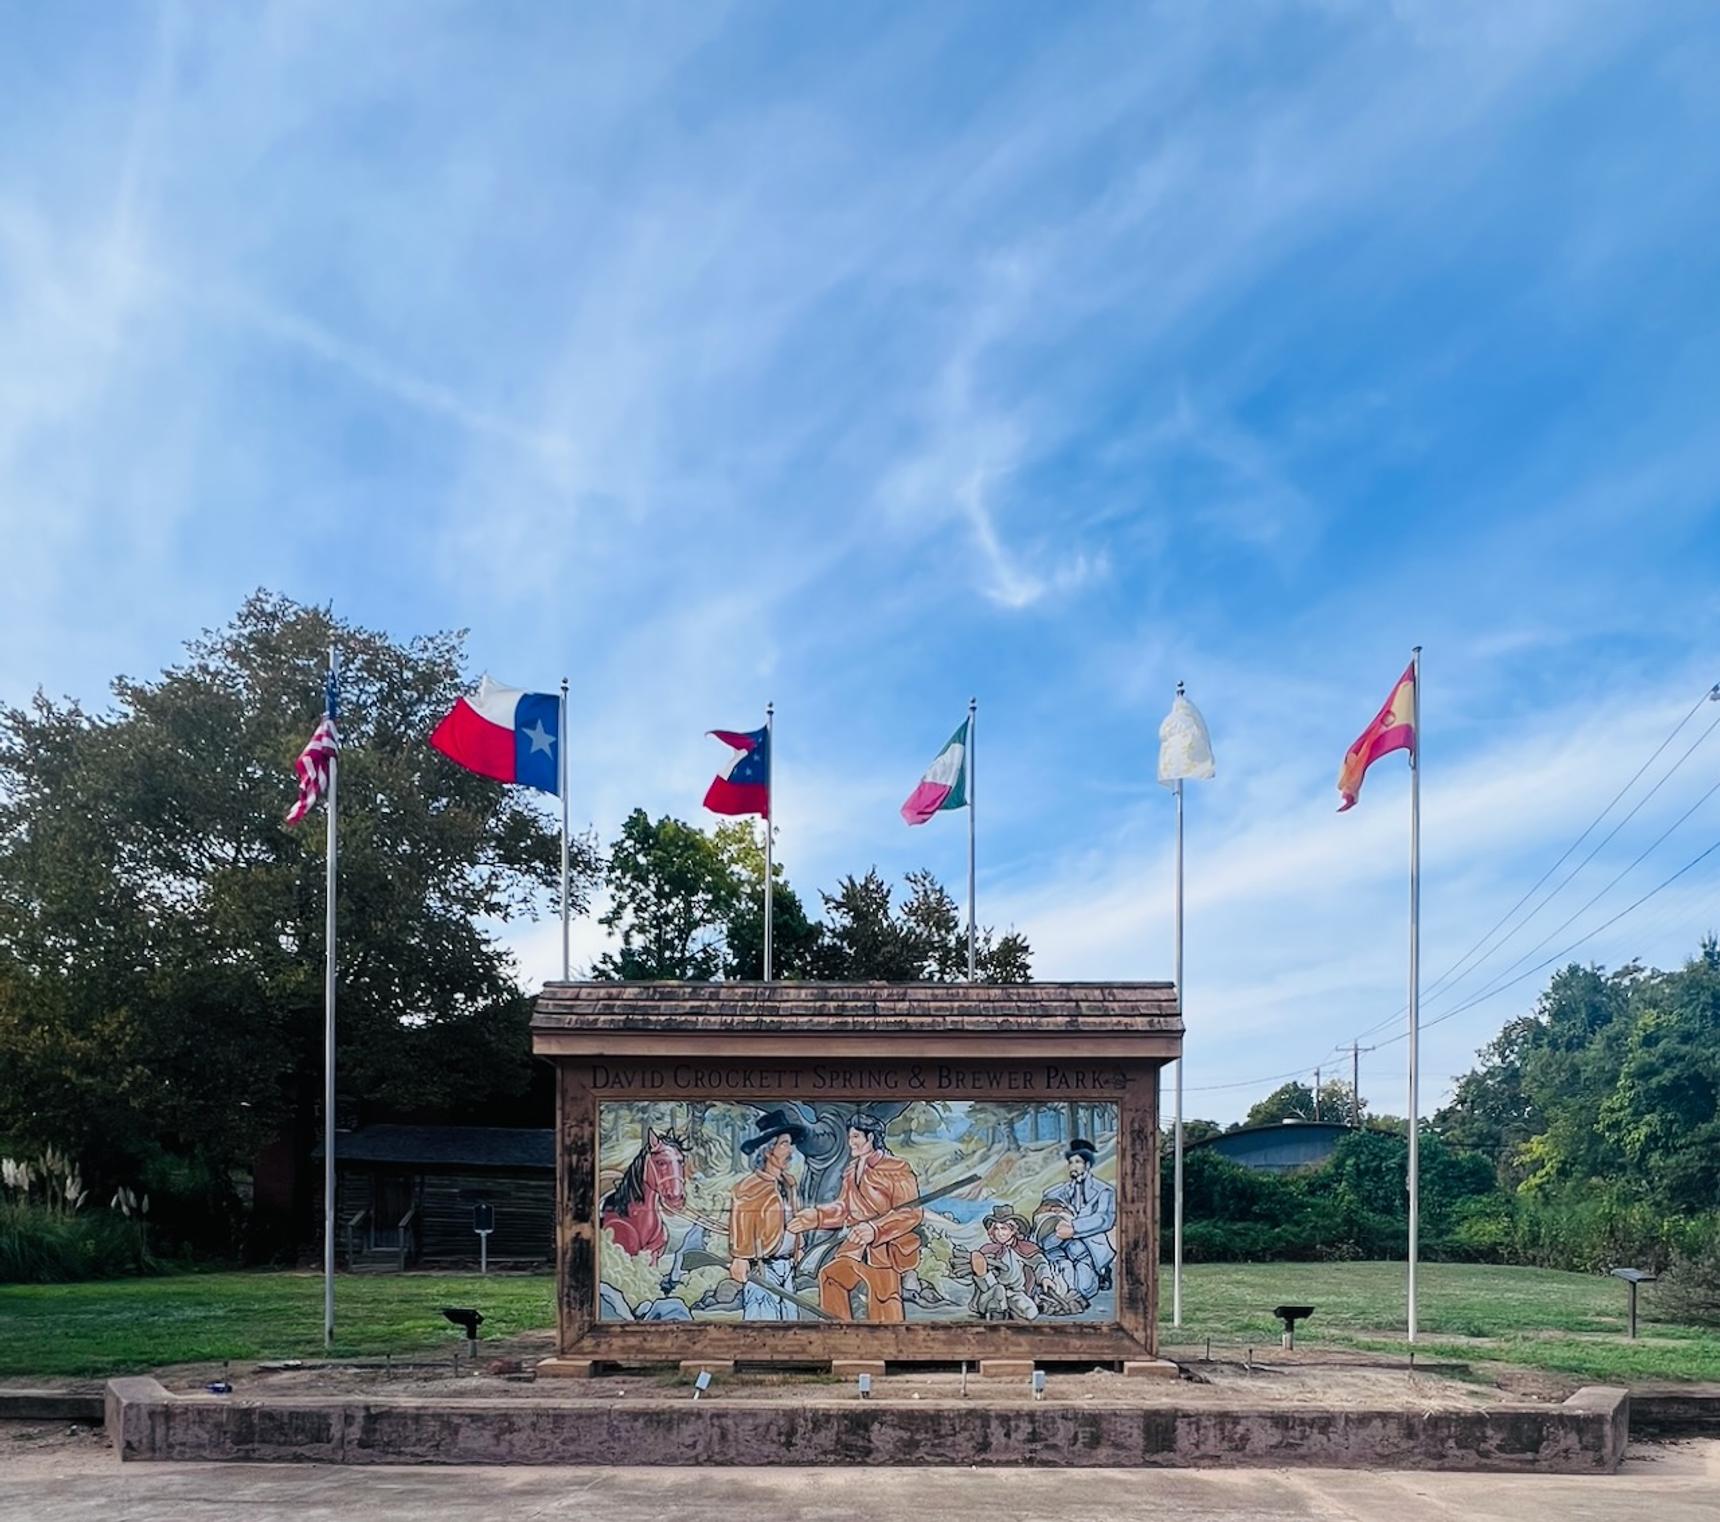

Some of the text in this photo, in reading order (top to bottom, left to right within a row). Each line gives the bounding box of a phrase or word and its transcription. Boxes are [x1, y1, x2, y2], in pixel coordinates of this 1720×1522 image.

[591, 1065, 1106, 1090] DAVID CROCKETT SPRING & BREWER PARK
